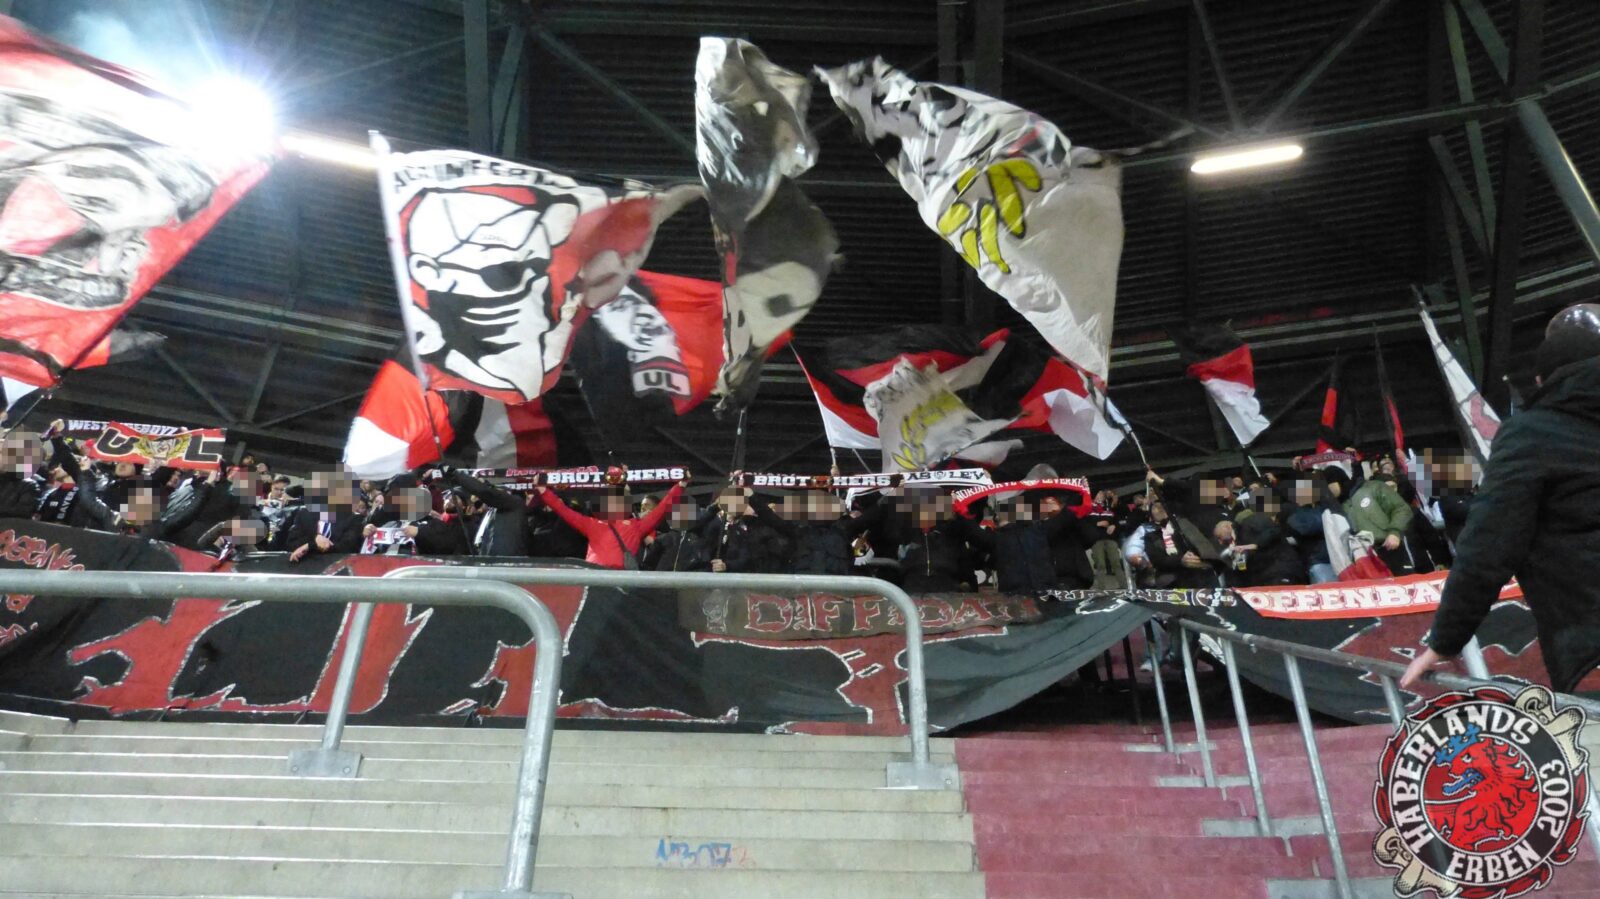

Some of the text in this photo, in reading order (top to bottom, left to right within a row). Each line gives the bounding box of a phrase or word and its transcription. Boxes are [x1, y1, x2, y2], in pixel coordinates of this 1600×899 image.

[643, 370, 682, 392] UL
[547, 471, 604, 485] BROT
[626, 468, 685, 482] HERS
[753, 475, 891, 487] BROT HERS
[1242, 578, 1447, 611] OFFENBA
